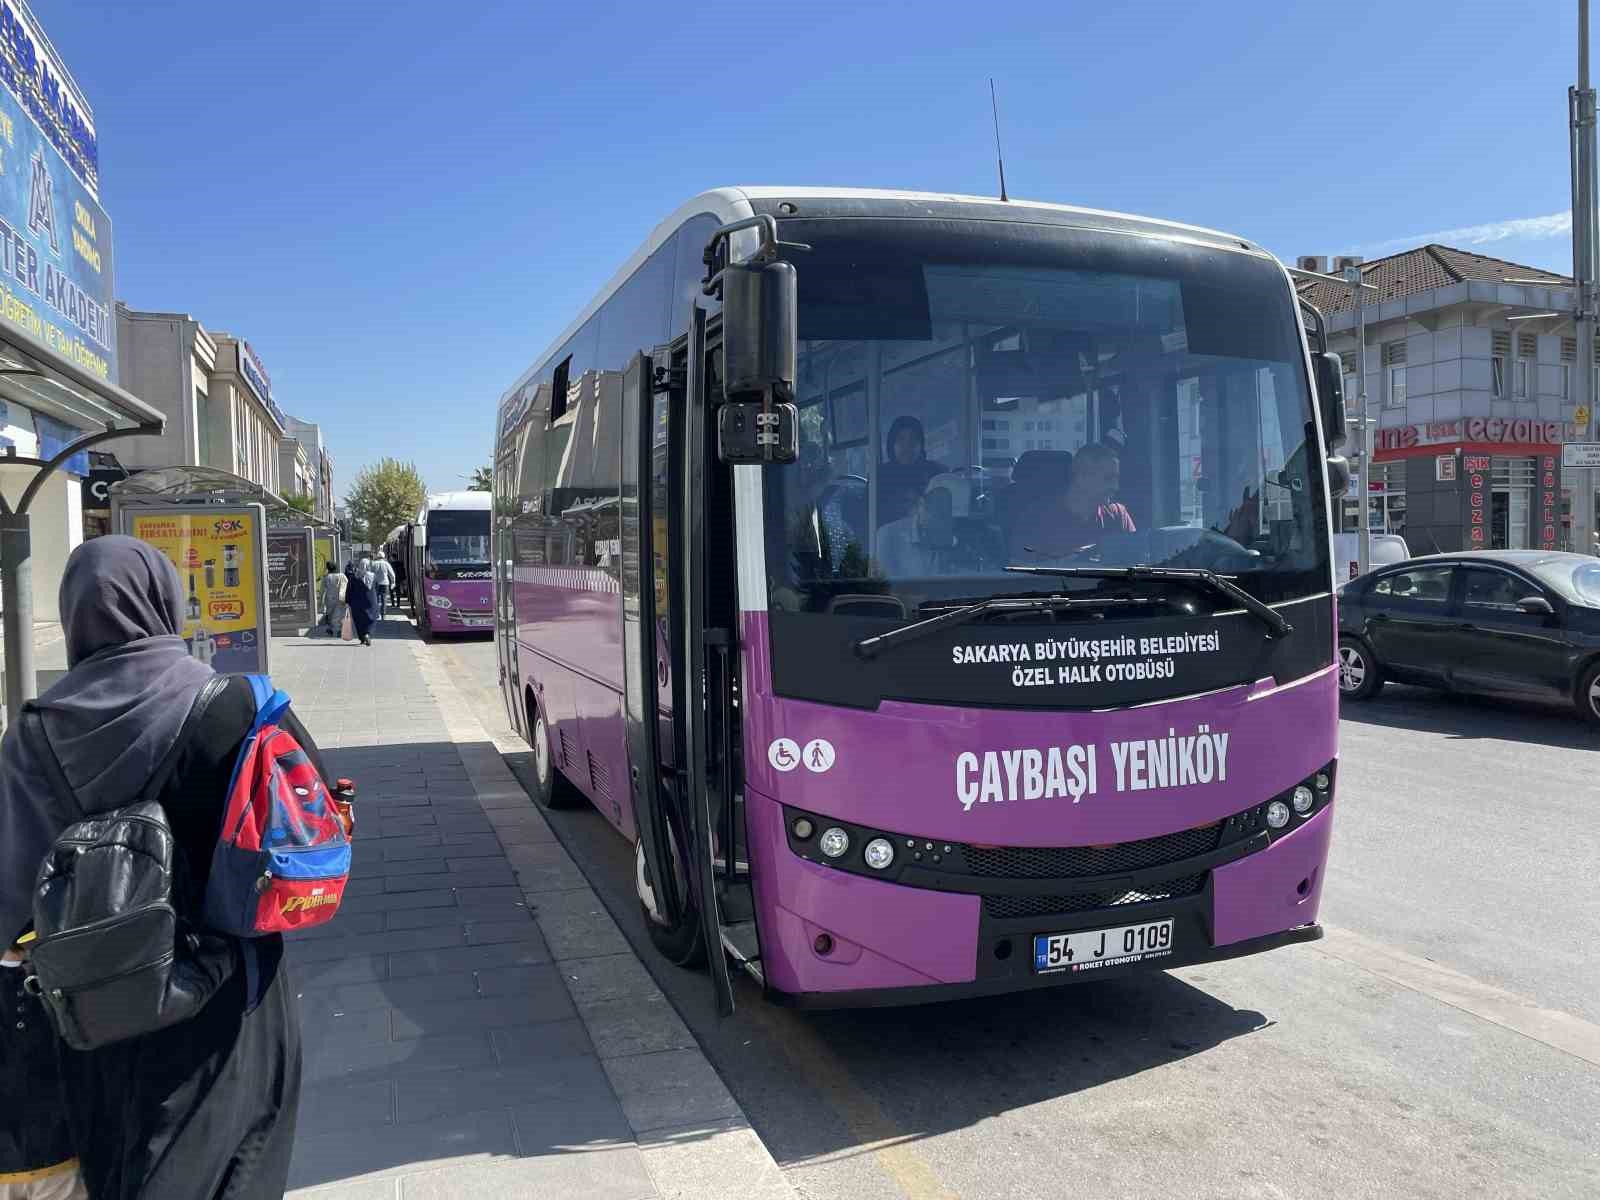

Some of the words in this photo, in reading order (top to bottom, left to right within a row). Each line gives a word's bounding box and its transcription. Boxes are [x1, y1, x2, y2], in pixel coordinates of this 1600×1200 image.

[45, 264, 110, 349] AKADEMİ
[1467, 416, 1556, 443] eczane
[952, 644, 1031, 665] SAKARYA
[1035, 635, 1136, 661] BÜYÜKŞEHİR
[1140, 630, 1221, 655] BELEDİYESİ
[1012, 665, 1054, 687] ÖZEL
[1058, 663, 1101, 684] HALK
[1106, 657, 1175, 682] OTOBÜSÜ
[956, 743, 1097, 811] ÇAYBAŞI
[1110, 724, 1229, 791] YENİKÖY
[1049, 938, 1074, 963] 54
[1094, 932, 1106, 958] J
[1123, 923, 1170, 953] 0109
[1079, 958, 1103, 971] ROKET
[1105, 953, 1142, 967] OTOMOTİV
